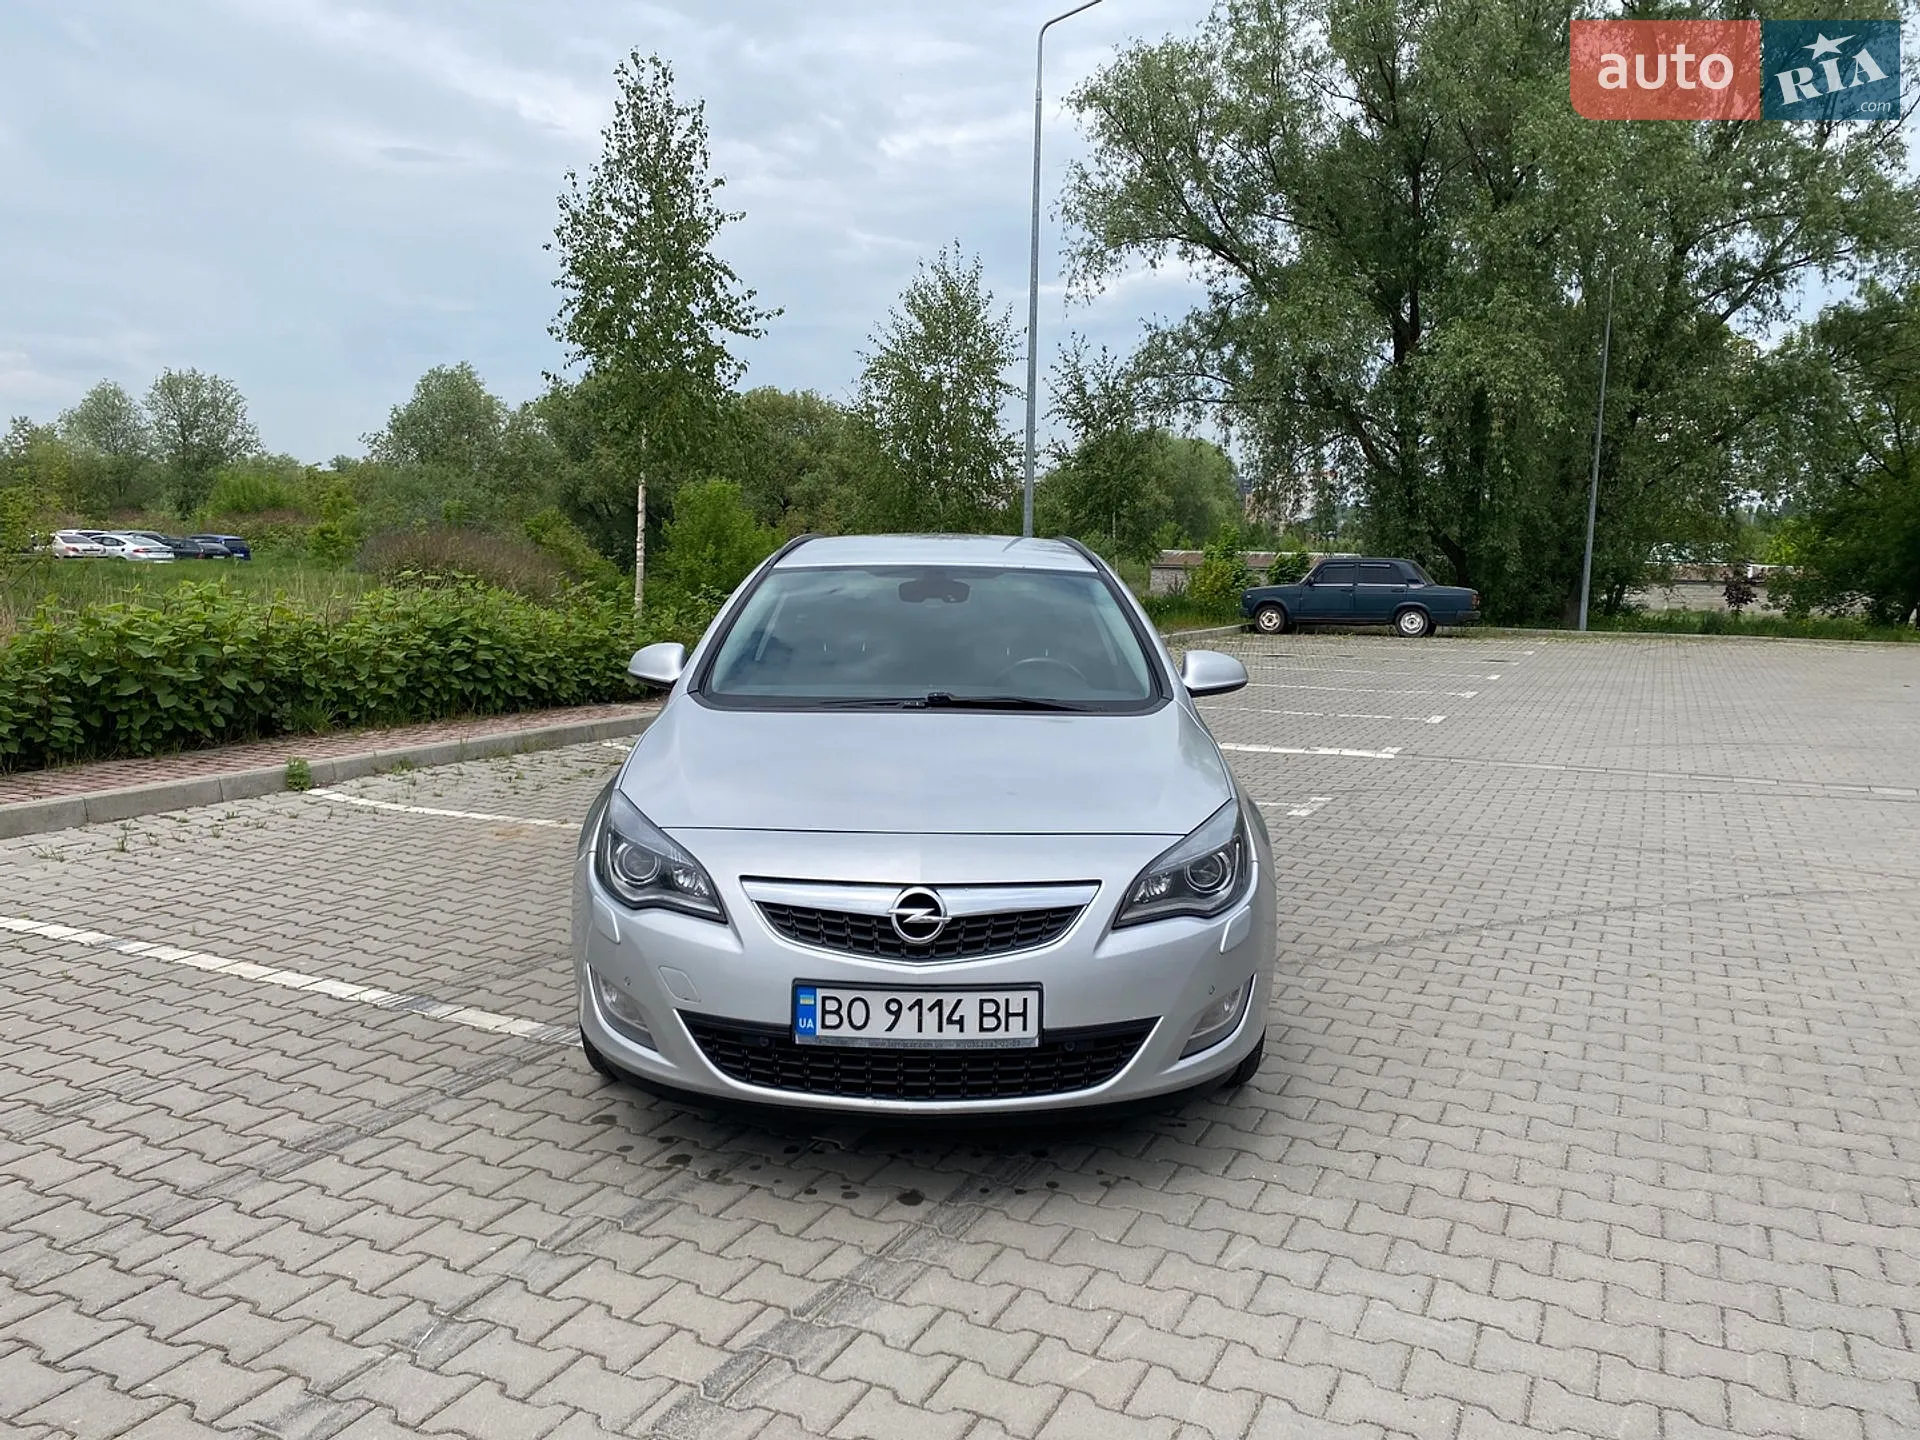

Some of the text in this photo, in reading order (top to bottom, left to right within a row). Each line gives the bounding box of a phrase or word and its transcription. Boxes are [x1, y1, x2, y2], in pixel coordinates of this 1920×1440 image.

[799, 1018, 815, 1029] UA
[820, 995, 1029, 1033] BO 9114 BH
